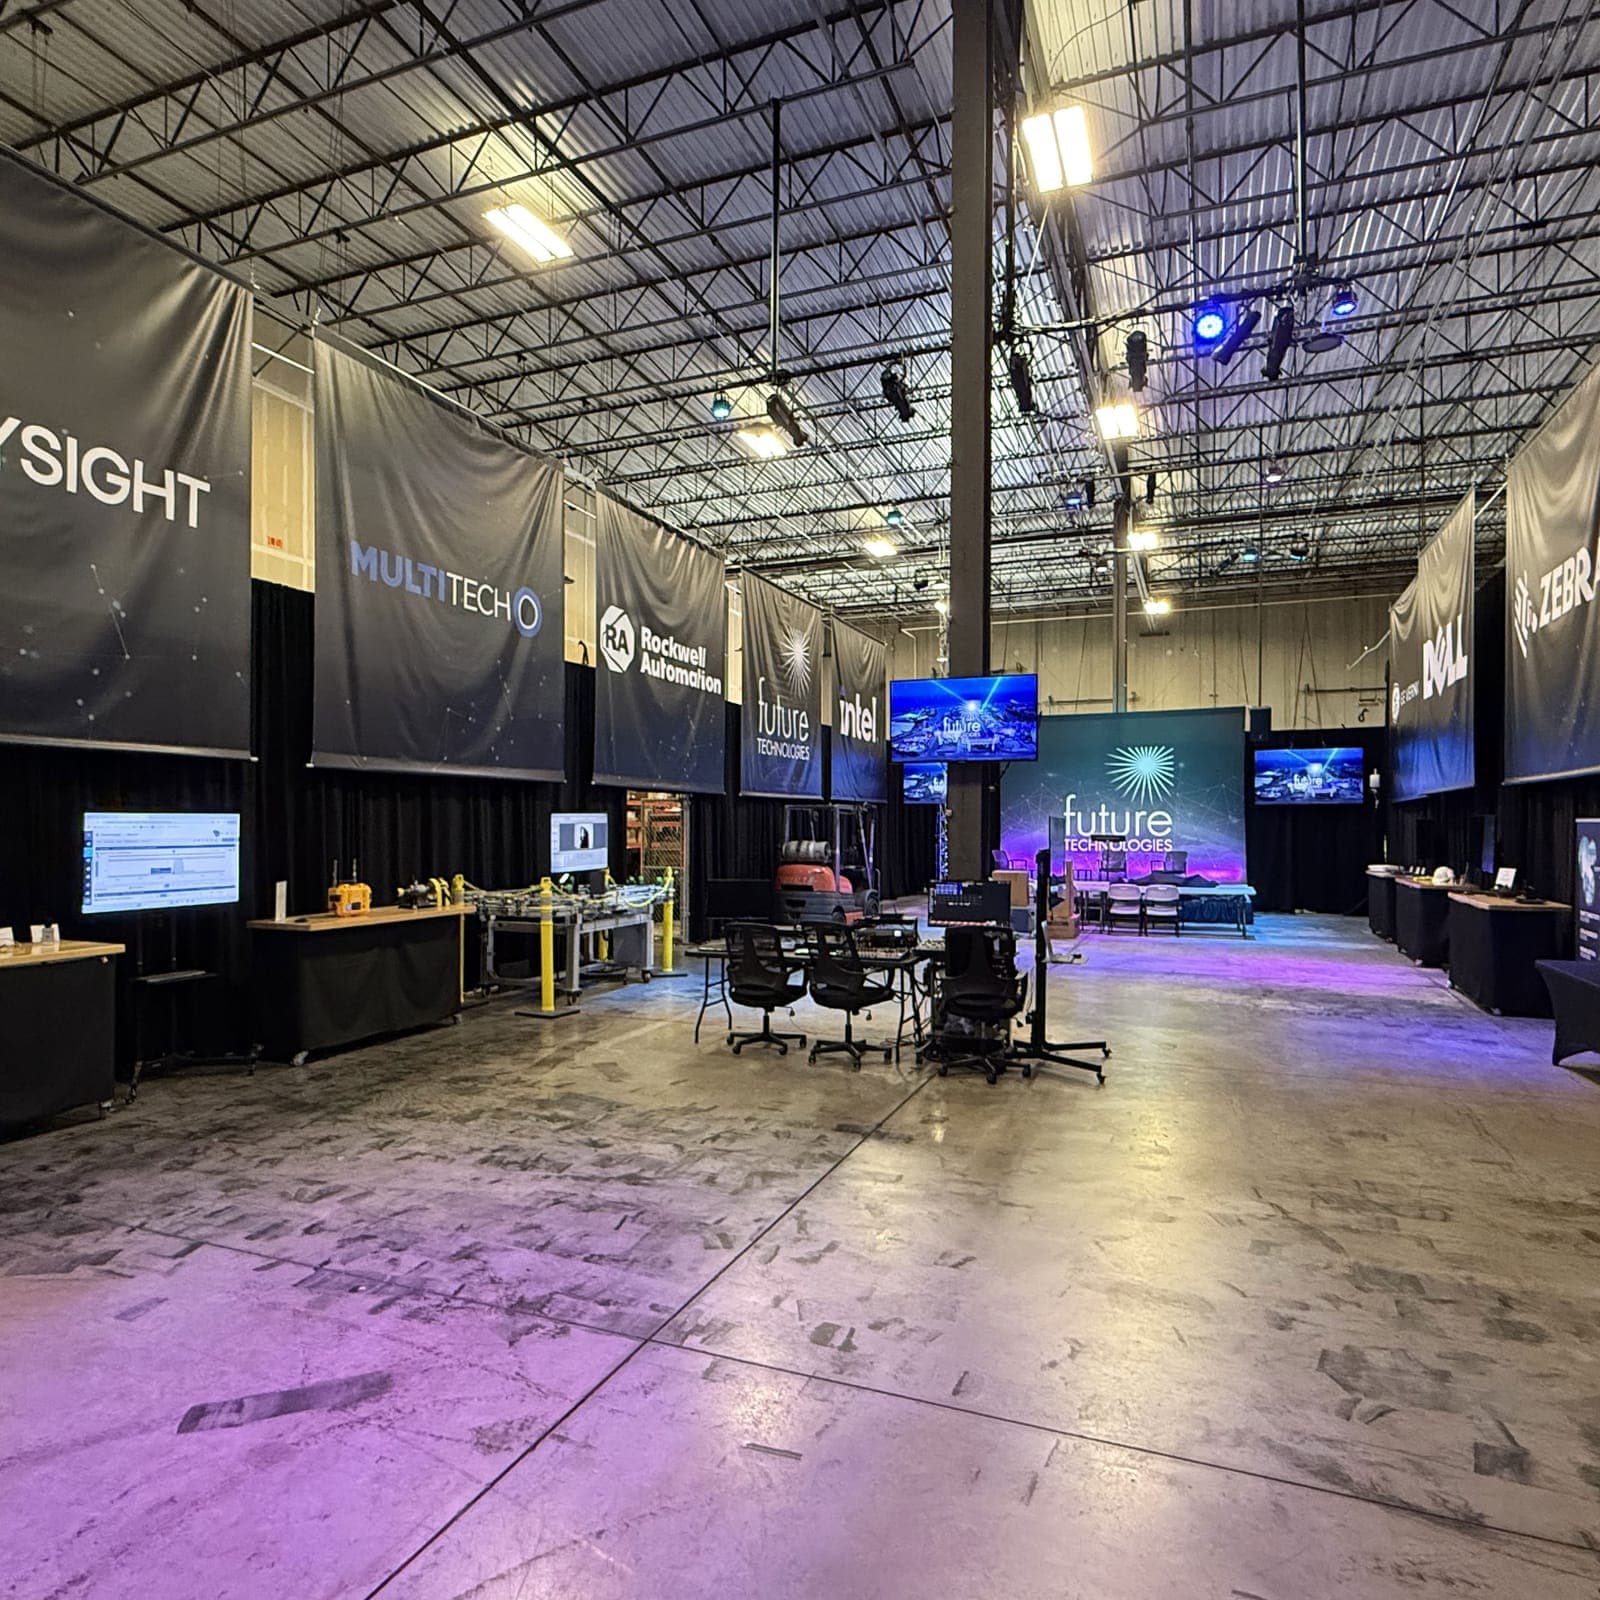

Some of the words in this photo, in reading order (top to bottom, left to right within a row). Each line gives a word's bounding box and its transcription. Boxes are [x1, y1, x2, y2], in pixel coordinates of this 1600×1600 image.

[641, 625, 707, 667] Rockwell
[640, 651, 722, 694] Automation
[758, 676, 809, 742] future
[840, 685, 877, 743] intel
[757, 737, 810, 760] TECHNOLOGIES
[1063, 793, 1173, 837] future
[1064, 838, 1173, 852] TECHNOLOGIES
